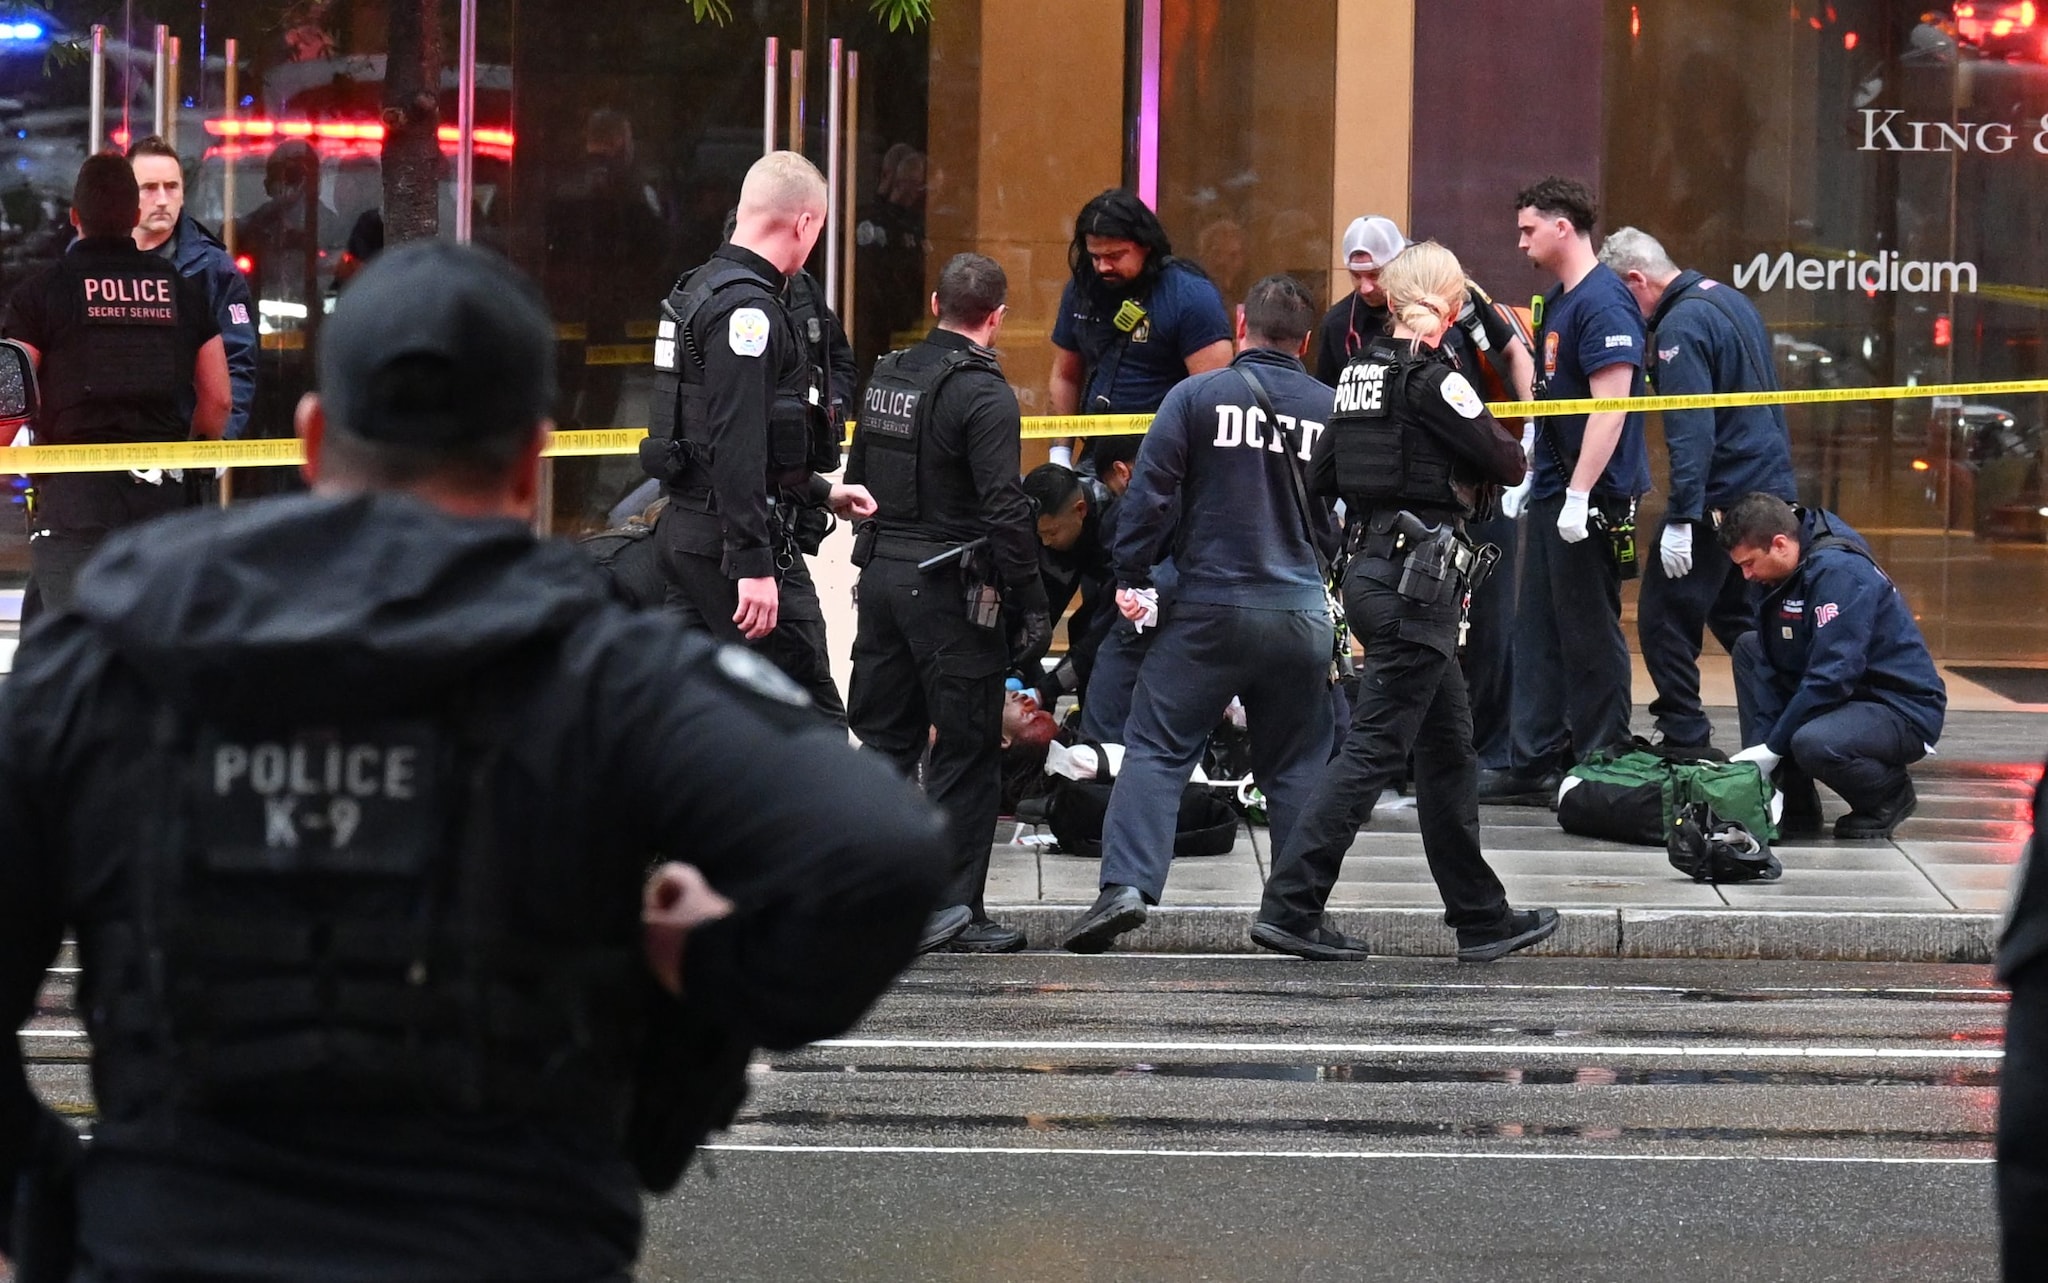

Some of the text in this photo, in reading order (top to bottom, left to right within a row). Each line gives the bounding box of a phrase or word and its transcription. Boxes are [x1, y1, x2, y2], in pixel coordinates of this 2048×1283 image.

[1856, 108, 2019, 154] KING
[1732, 249, 1978, 293] Meridiam
[84, 278, 171, 303] POLICE
[87, 306, 172, 319] SECRET SERVICE
[864, 387, 916, 418] POLICE
[1333, 380, 1384, 413] POLICE
[1212, 404, 1326, 462] DCFD
[1814, 602, 1840, 628] 16
[213, 742, 417, 800] POLICE
[263, 796, 362, 849] K-9
